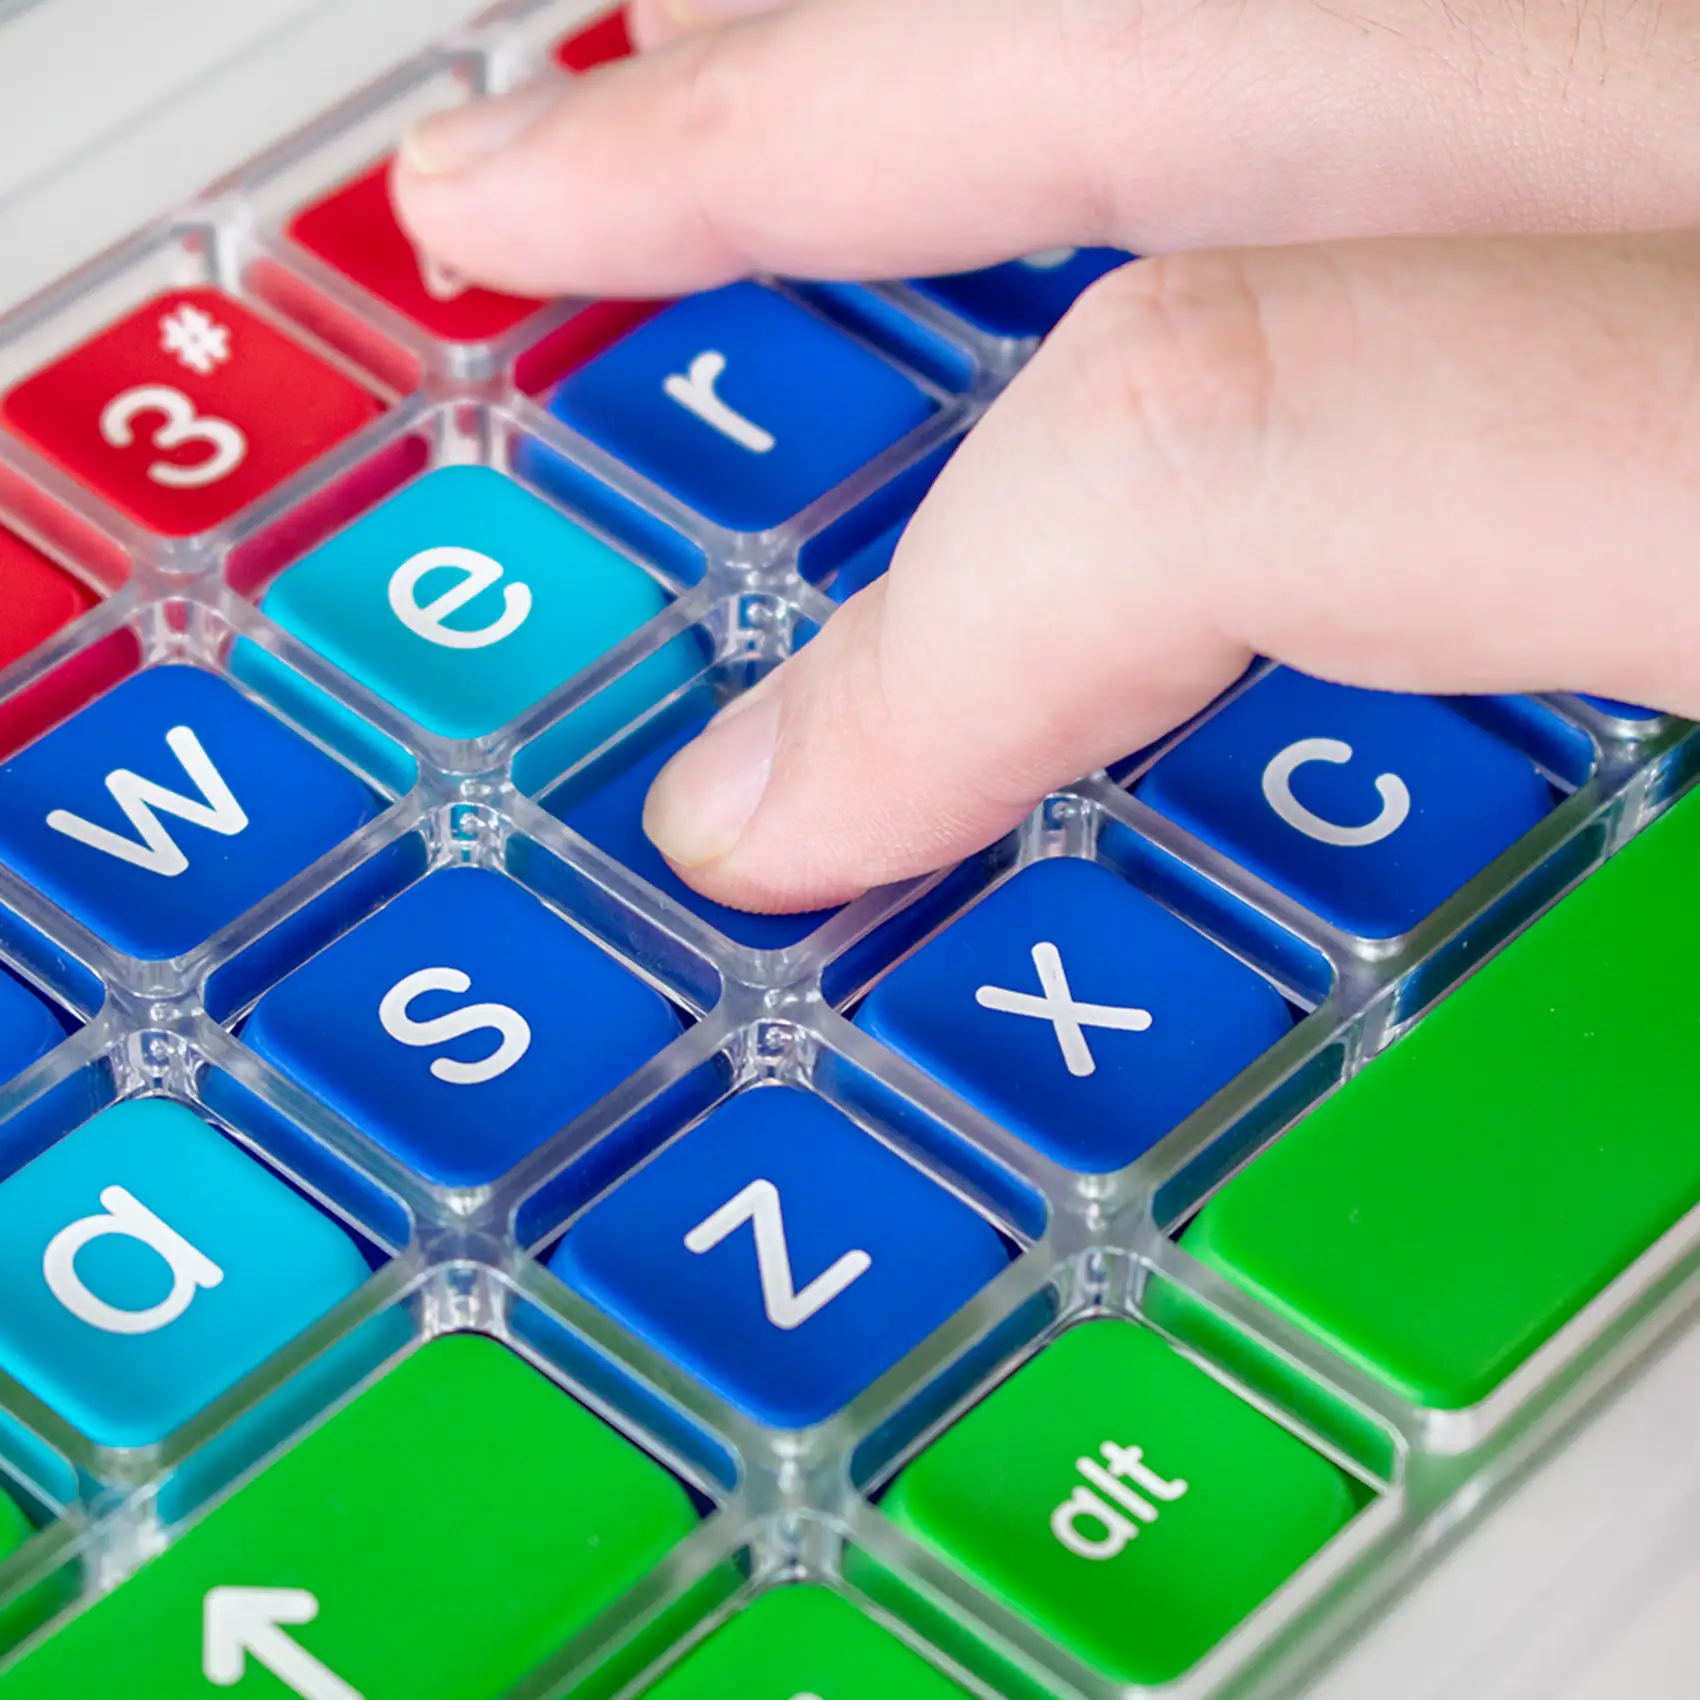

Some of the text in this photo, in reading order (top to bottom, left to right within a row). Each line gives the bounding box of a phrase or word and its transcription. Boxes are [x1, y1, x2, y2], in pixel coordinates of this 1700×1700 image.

[100, 384, 246, 487] 3
[663, 350, 776, 453] r
[386, 545, 534, 649] e
[45, 724, 250, 877] w
[1261, 737, 1411, 846] c
[378, 966, 531, 1085] s
[974, 941, 1152, 1078] x
[42, 1184, 225, 1335] a
[683, 1178, 872, 1330] z
[1050, 1440, 1188, 1560] alt
